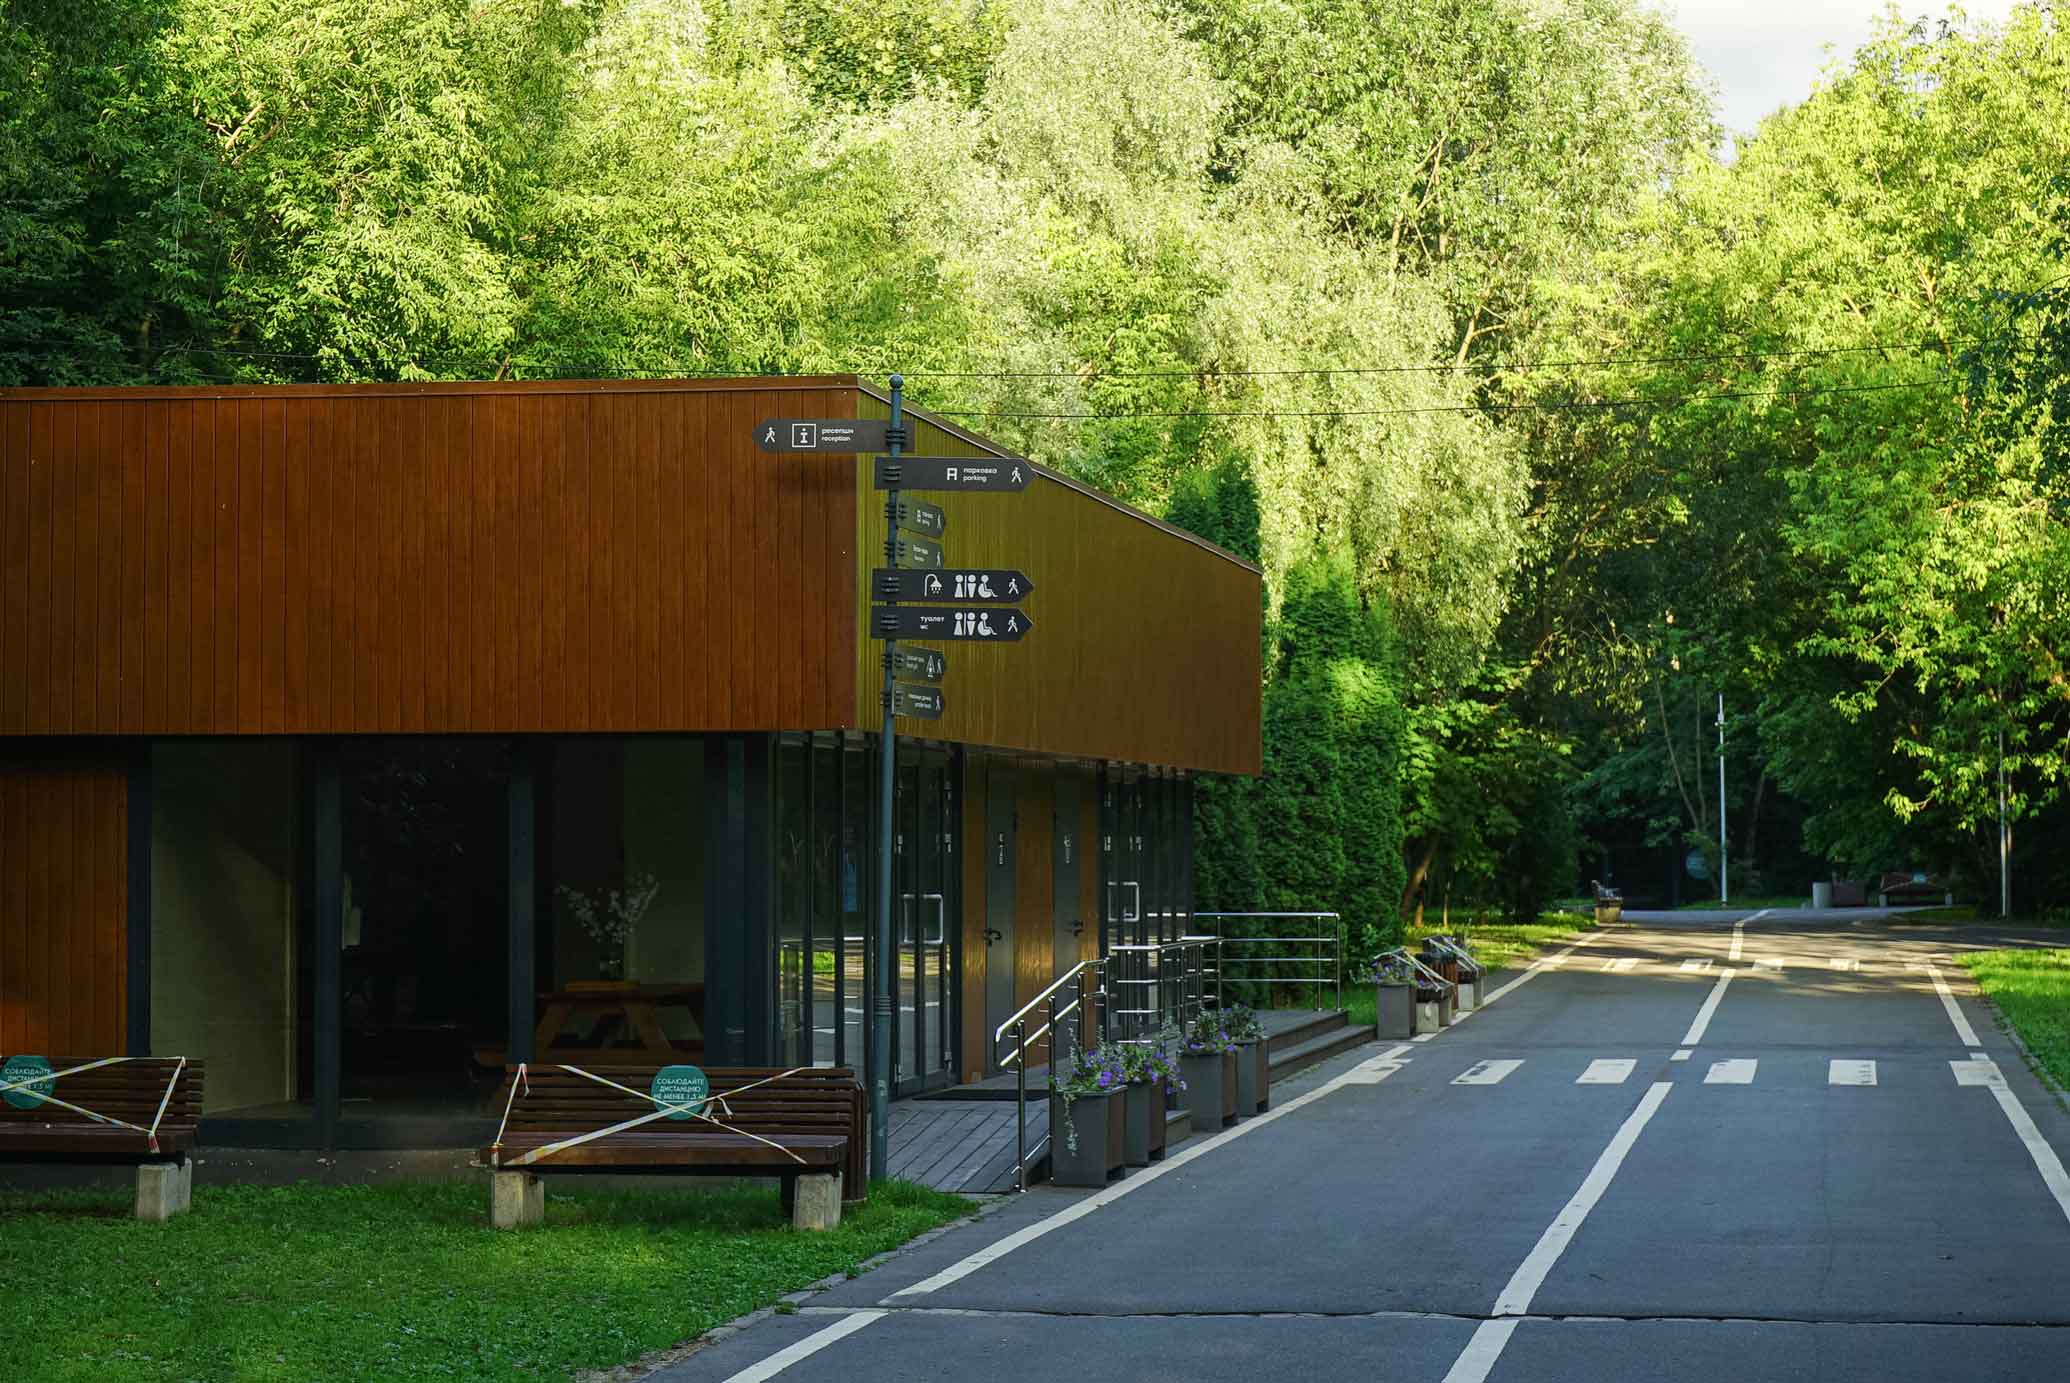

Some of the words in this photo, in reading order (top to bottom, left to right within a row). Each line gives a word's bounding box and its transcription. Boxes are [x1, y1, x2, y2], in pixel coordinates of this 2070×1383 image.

[963, 467, 998, 475] парковка
[963, 475, 987, 483] parking
[920, 616, 945, 624] туалет
